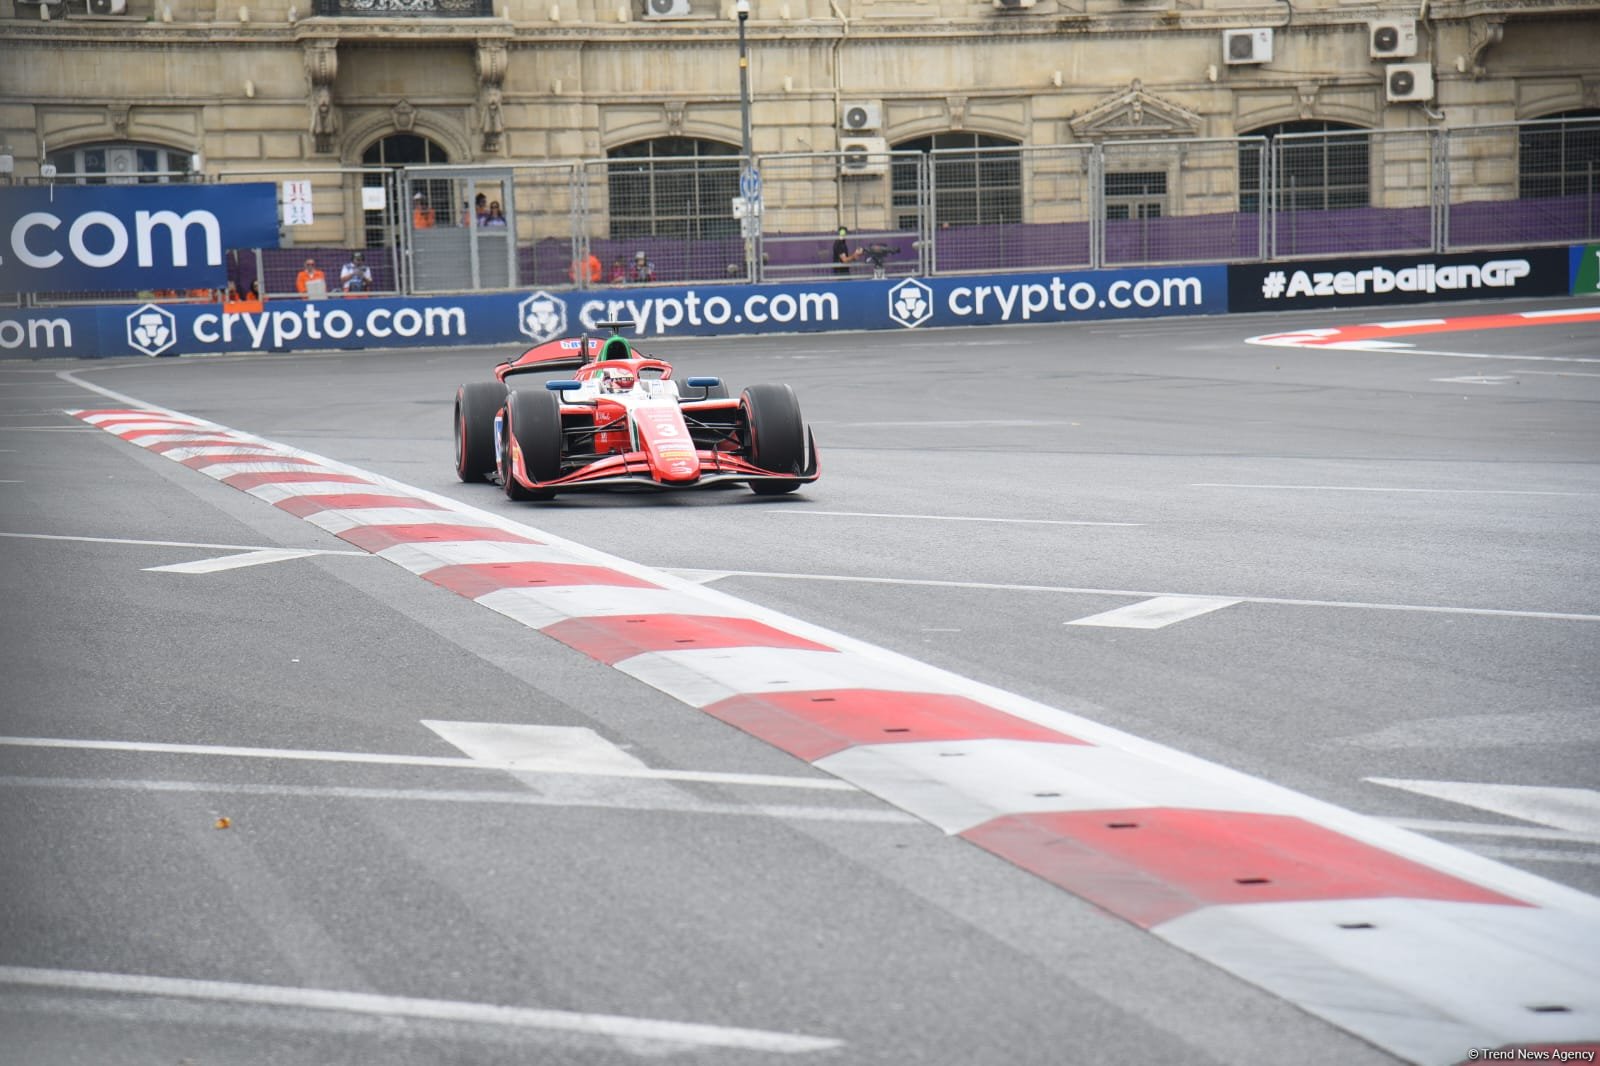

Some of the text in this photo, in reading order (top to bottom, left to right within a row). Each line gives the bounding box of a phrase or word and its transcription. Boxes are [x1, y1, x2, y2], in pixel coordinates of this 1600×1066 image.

[0, 210, 223, 269] com
[579, 290, 839, 335] crypto.com
[948, 276, 1203, 321] crypto.com
[192, 303, 467, 349] crypto.com
[656, 423, 679, 437] 3
